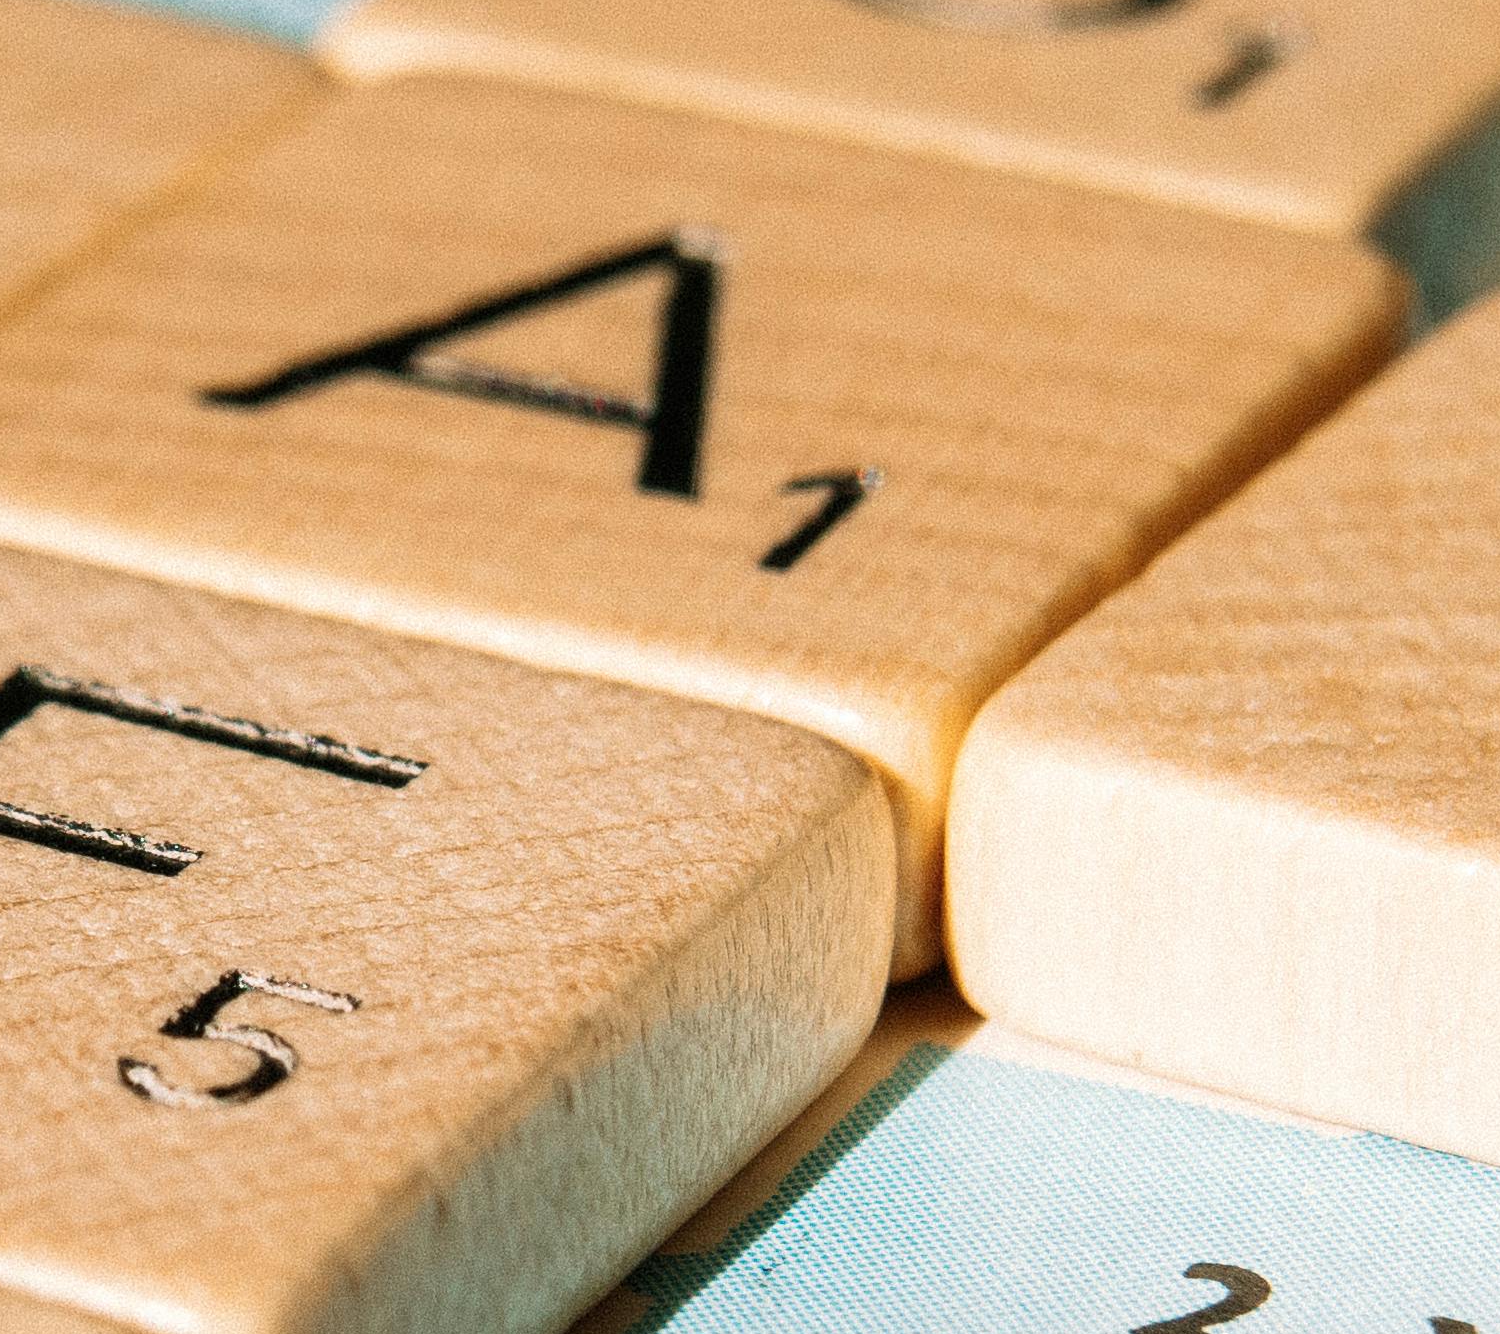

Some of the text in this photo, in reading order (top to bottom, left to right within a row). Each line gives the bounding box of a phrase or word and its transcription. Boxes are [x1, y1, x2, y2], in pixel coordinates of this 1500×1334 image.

[195, 229, 888, 572] A 1
[116, 968, 362, 1108] 5
